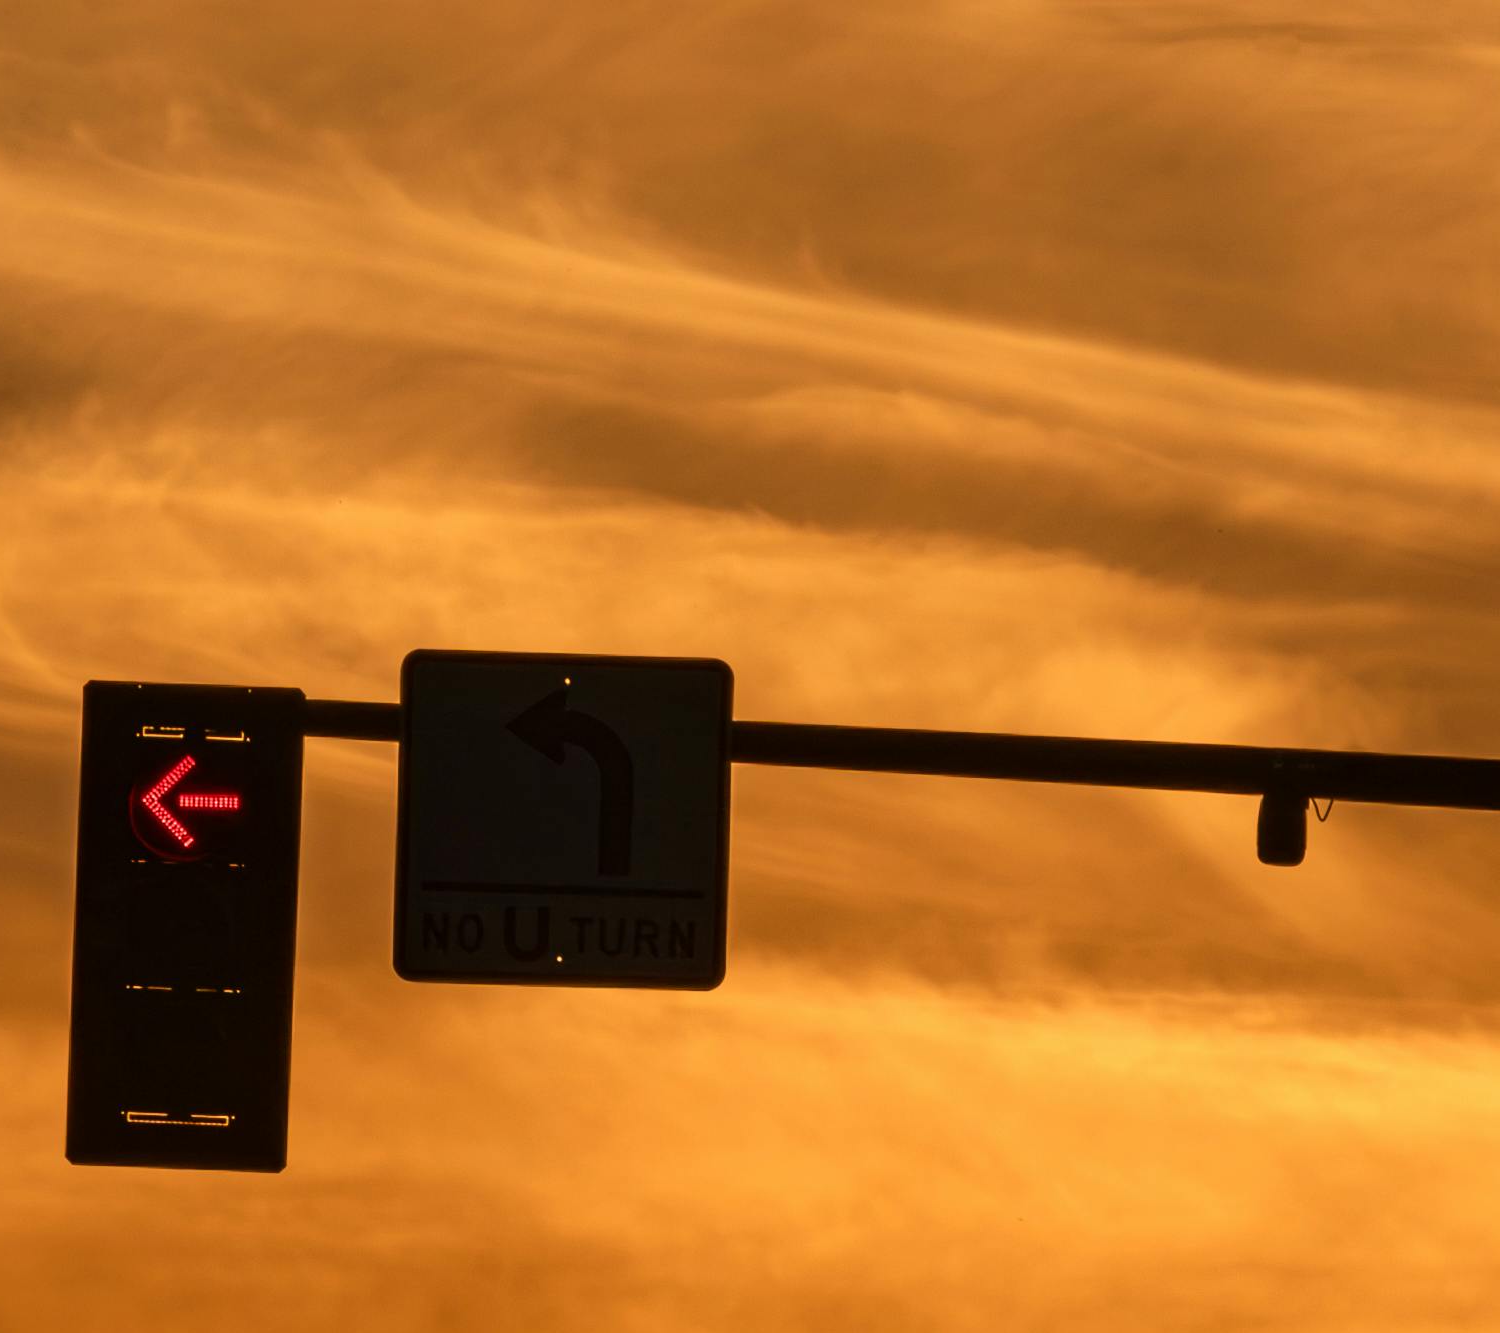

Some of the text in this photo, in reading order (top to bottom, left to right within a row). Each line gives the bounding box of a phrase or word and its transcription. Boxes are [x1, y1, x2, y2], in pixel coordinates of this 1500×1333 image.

[422, 907, 696, 961] NO U TURN
